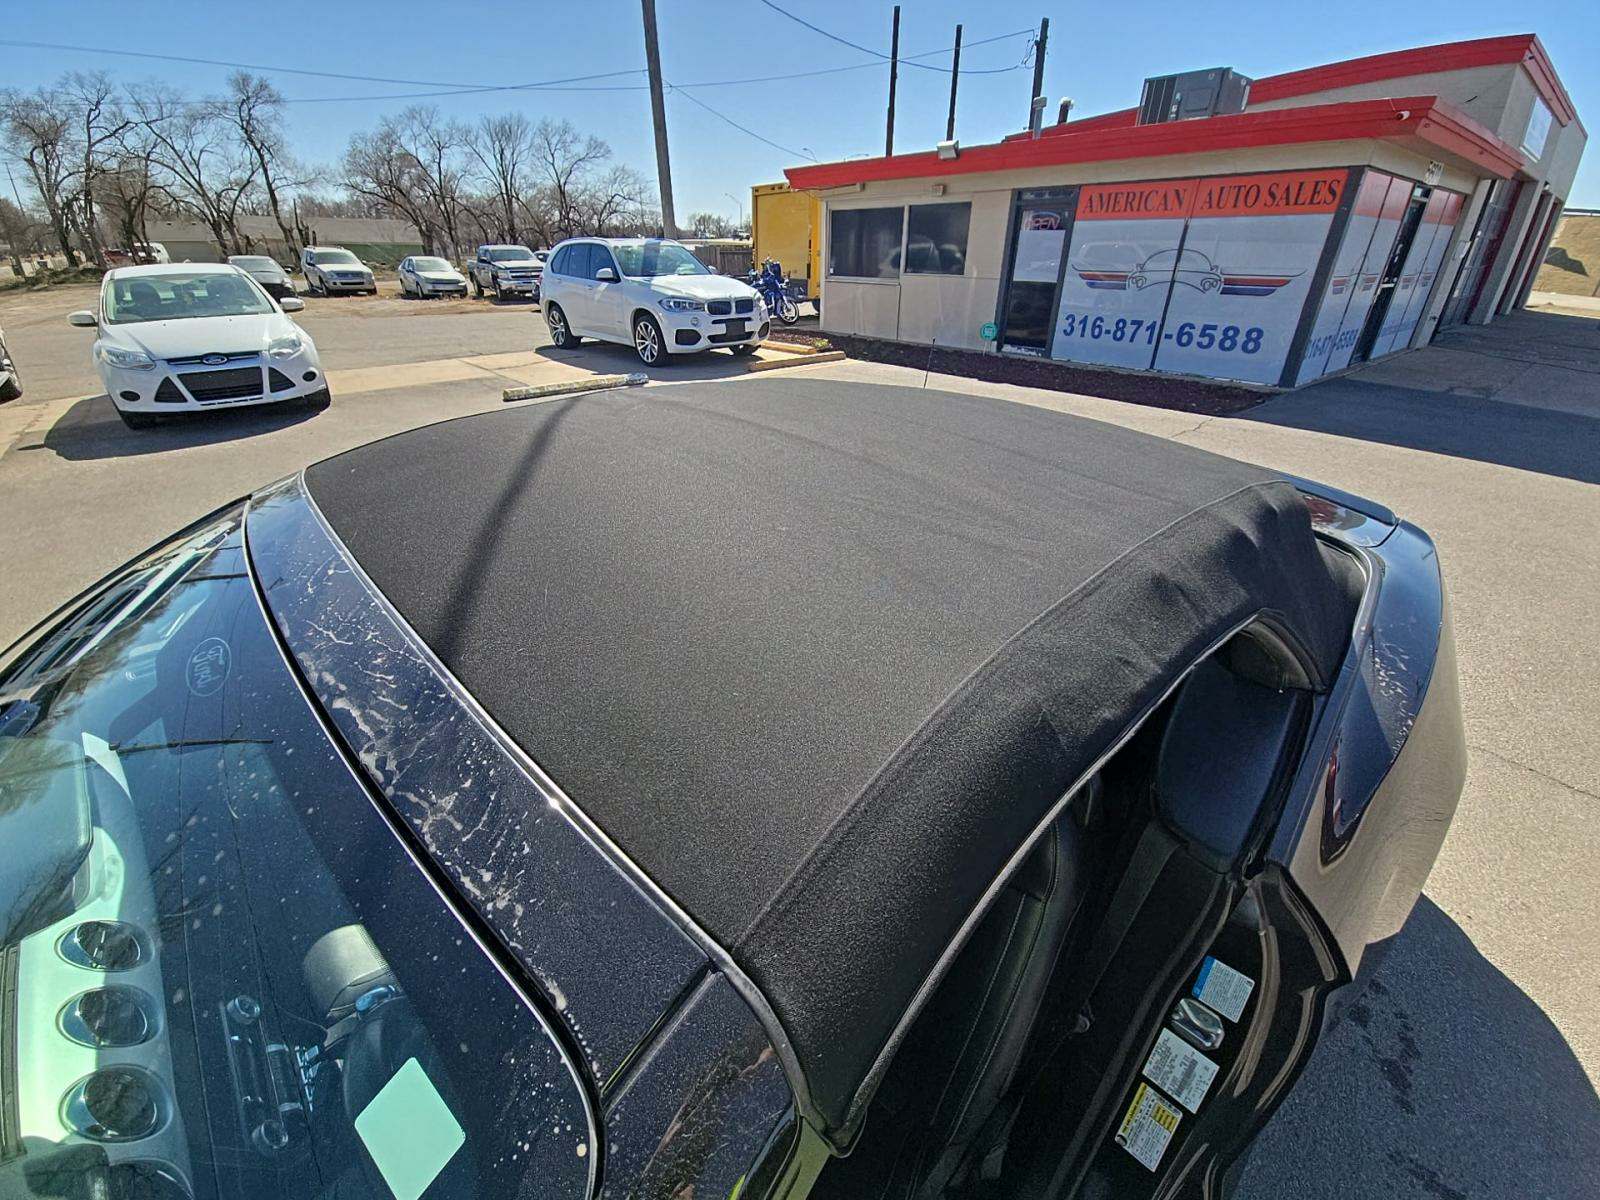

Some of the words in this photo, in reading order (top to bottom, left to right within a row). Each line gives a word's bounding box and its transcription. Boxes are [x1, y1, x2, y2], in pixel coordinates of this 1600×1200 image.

[1083, 187, 1188, 214] AMERICAN
[1200, 183, 1261, 210] AUTO
[1263, 179, 1340, 207] SALES
